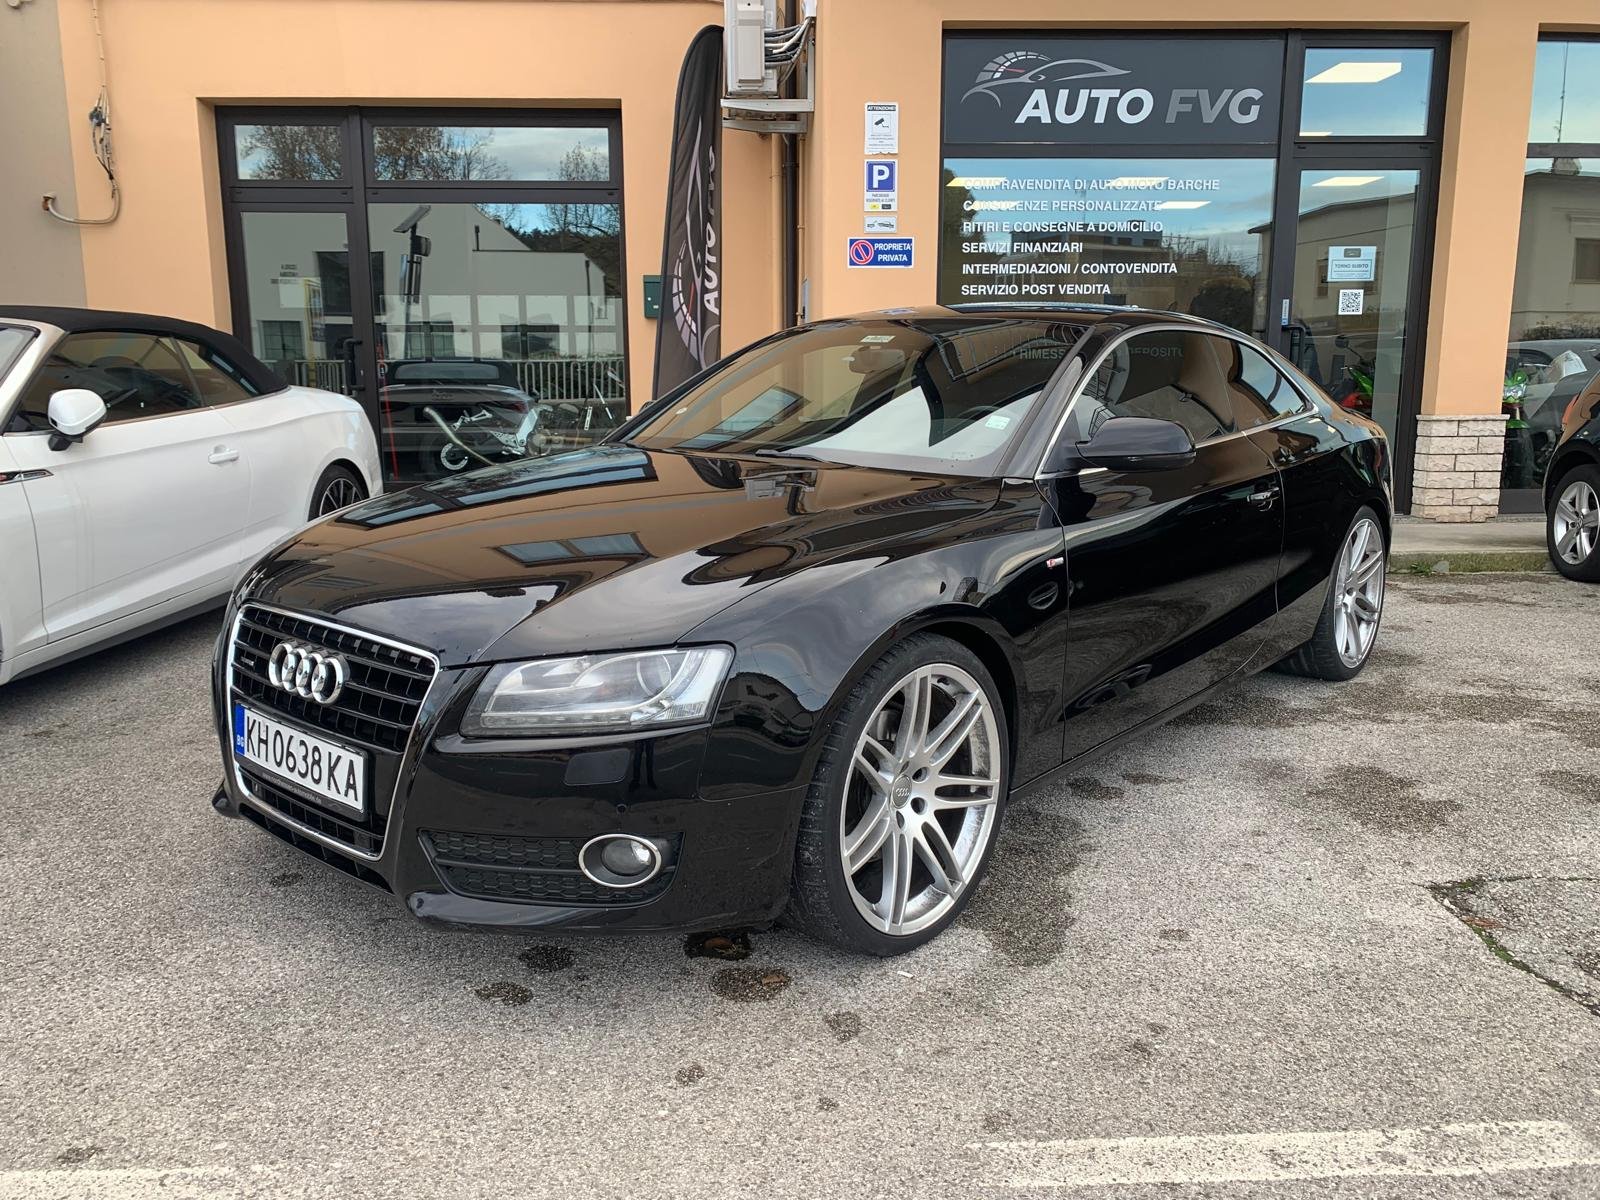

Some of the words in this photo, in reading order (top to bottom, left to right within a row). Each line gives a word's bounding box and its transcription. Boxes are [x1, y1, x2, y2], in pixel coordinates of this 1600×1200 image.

[1014, 88, 1154, 124] AUTO
[1165, 88, 1264, 124] FVG
[872, 164, 890, 189] P
[1074, 179, 1087, 190] DI
[1089, 179, 1124, 190] AUTO
[1127, 179, 1164, 190] MOTO
[1167, 179, 1220, 190] BARCHE
[1052, 200, 1162, 211] PERSONALIZZATE
[963, 221, 999, 232] RITIRI
[1002, 221, 1010, 232] E
[1013, 221, 1084, 232] CONSEGNE
[1086, 221, 1097, 232] A
[1098, 221, 1163, 232] DOMICILIO
[962, 242, 1010, 253] SERVIZI
[1013, 242, 1083, 253] FINANZIARI
[878, 254, 908, 262] PRIVATA
[703, 222, 720, 316] AUTO
[962, 263, 1071, 274] INTERMEDIAZIONI
[1073, 263, 1079, 274] /
[1081, 263, 1177, 274] CONTOVENDITA
[961, 284, 1018, 295] SERVIZIO
[1021, 284, 1055, 295] POST
[1058, 284, 1111, 294] VENDITA
[1019, 349, 1066, 360] RIMESS
